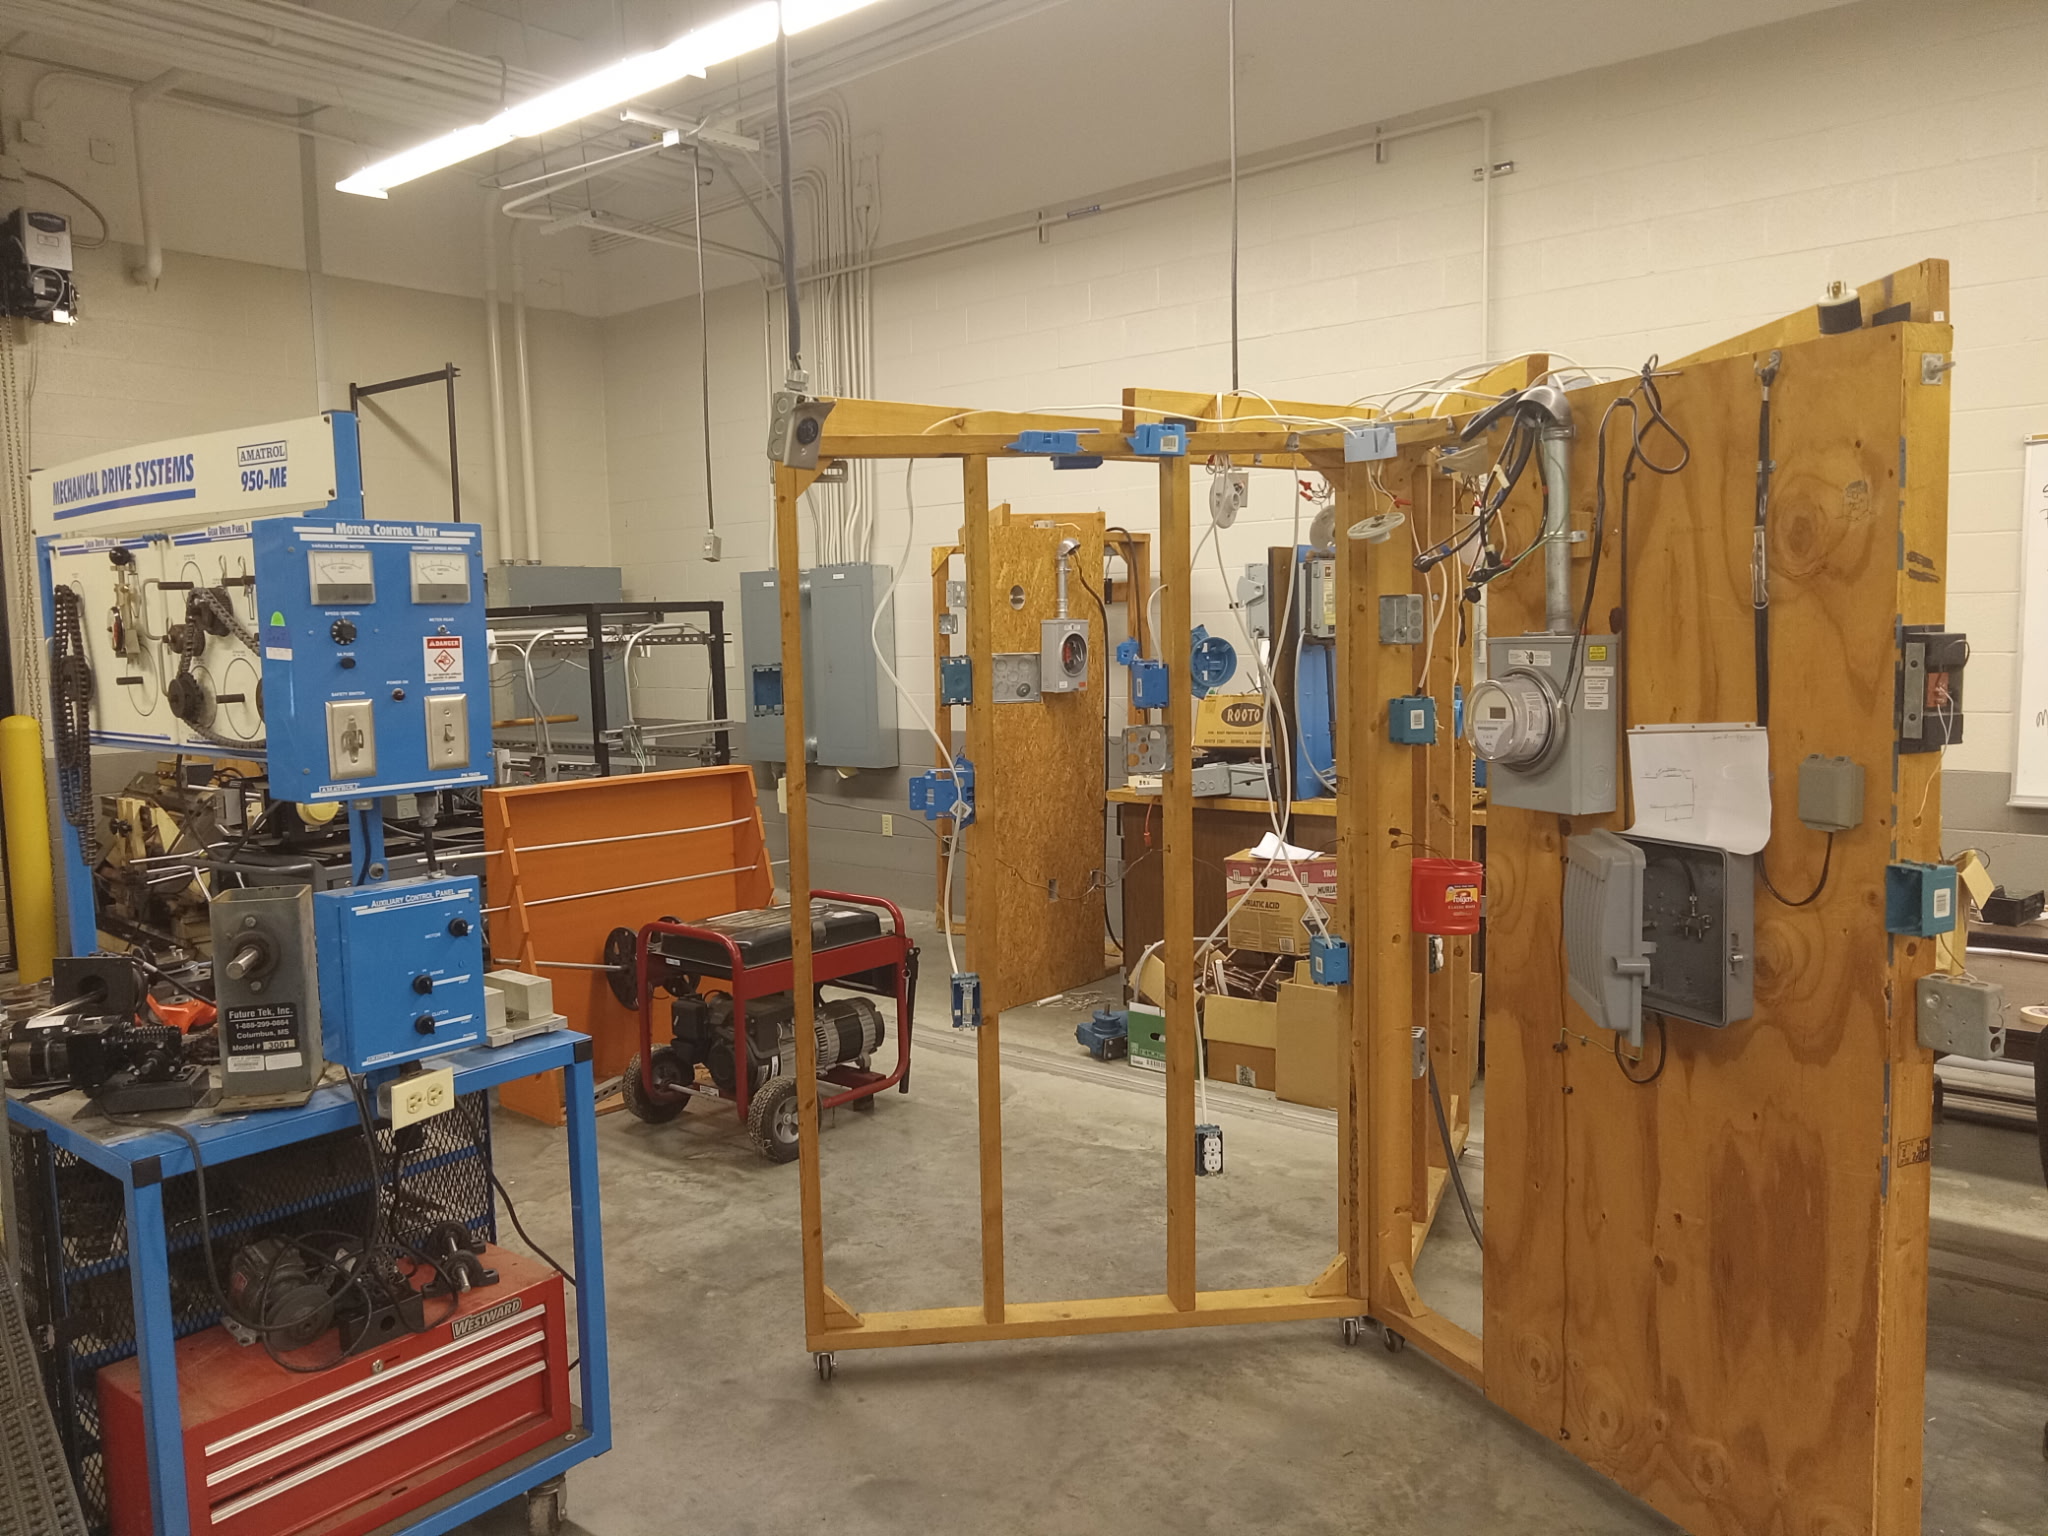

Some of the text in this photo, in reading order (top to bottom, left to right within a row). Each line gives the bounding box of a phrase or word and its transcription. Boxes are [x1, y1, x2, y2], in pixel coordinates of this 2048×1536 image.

[240, 444, 286, 463] AMATROL
[53, 454, 194, 505] MECHANICAL DRIVE SYSTEMS
[241, 466, 287, 492] 950-ME
[219, 525, 231, 535] DRIVE
[232, 524, 245, 534] PANEL
[335, 523, 438, 537] MOTOR CONTROL UNIT
[1227, 708, 1261, 722] ROOTO
[1317, 885, 1337, 894] MURIA
[371, 889, 455, 908] AUXILIARY CONTROL PANEL
[1265, 901, 1280, 909] ACID
[229, 1007, 294, 1019] Future Tek, Inc.
[431, 1009, 449, 1017] CLUTCH
[236, 1031, 276, 1039] Columbus,
[232, 1043, 255, 1051] Model
[268, 1041, 289, 1049] 3001
[454, 1299, 520, 1336] WESTWARD
